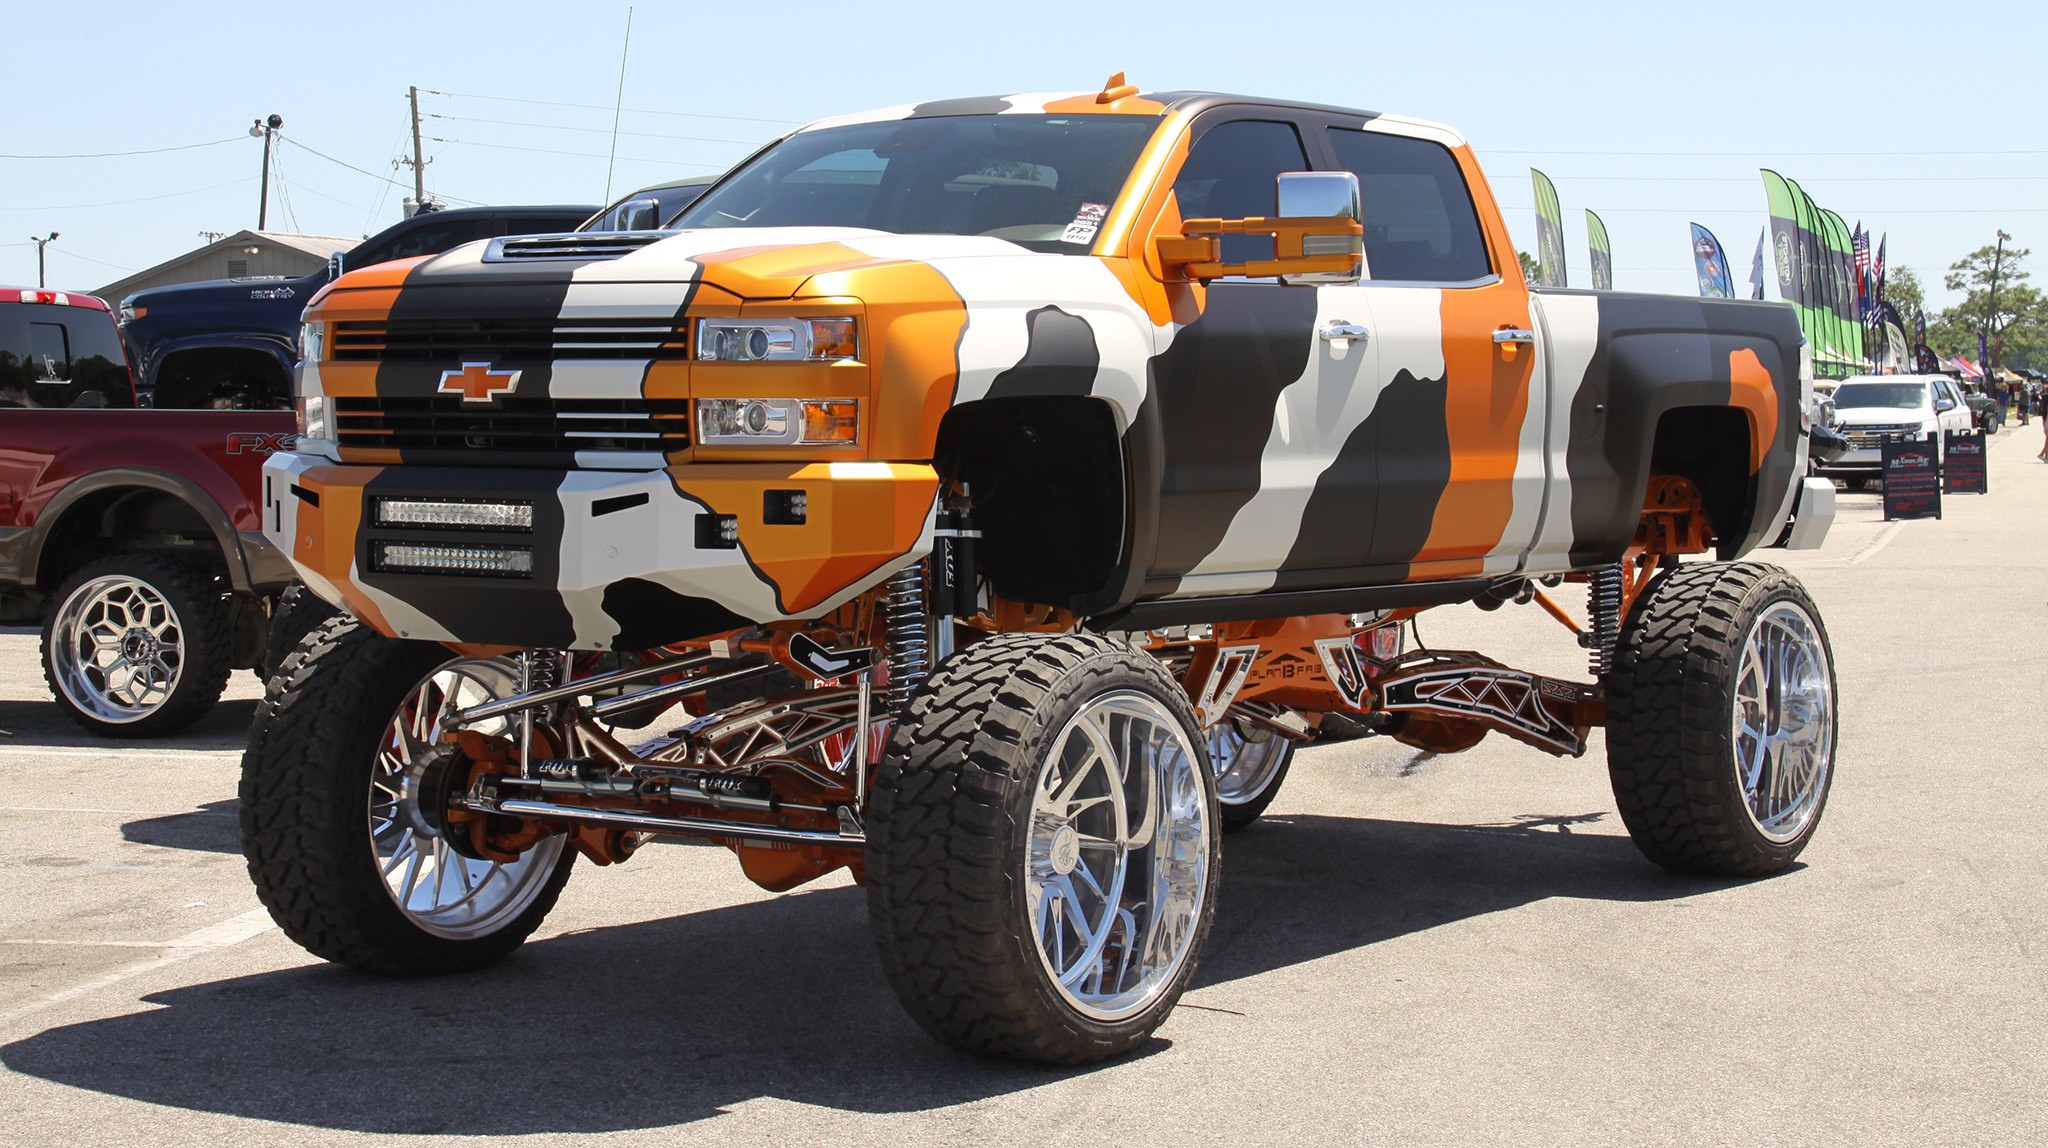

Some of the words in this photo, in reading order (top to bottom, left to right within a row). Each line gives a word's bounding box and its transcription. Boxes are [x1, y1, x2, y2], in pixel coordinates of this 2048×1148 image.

[944, 538, 955, 589] FOX
[1249, 667, 1282, 680] PLAN
[1296, 664, 1322, 676] FAB
[538, 760, 573, 775] FOX
[708, 778, 745, 791] FOX
